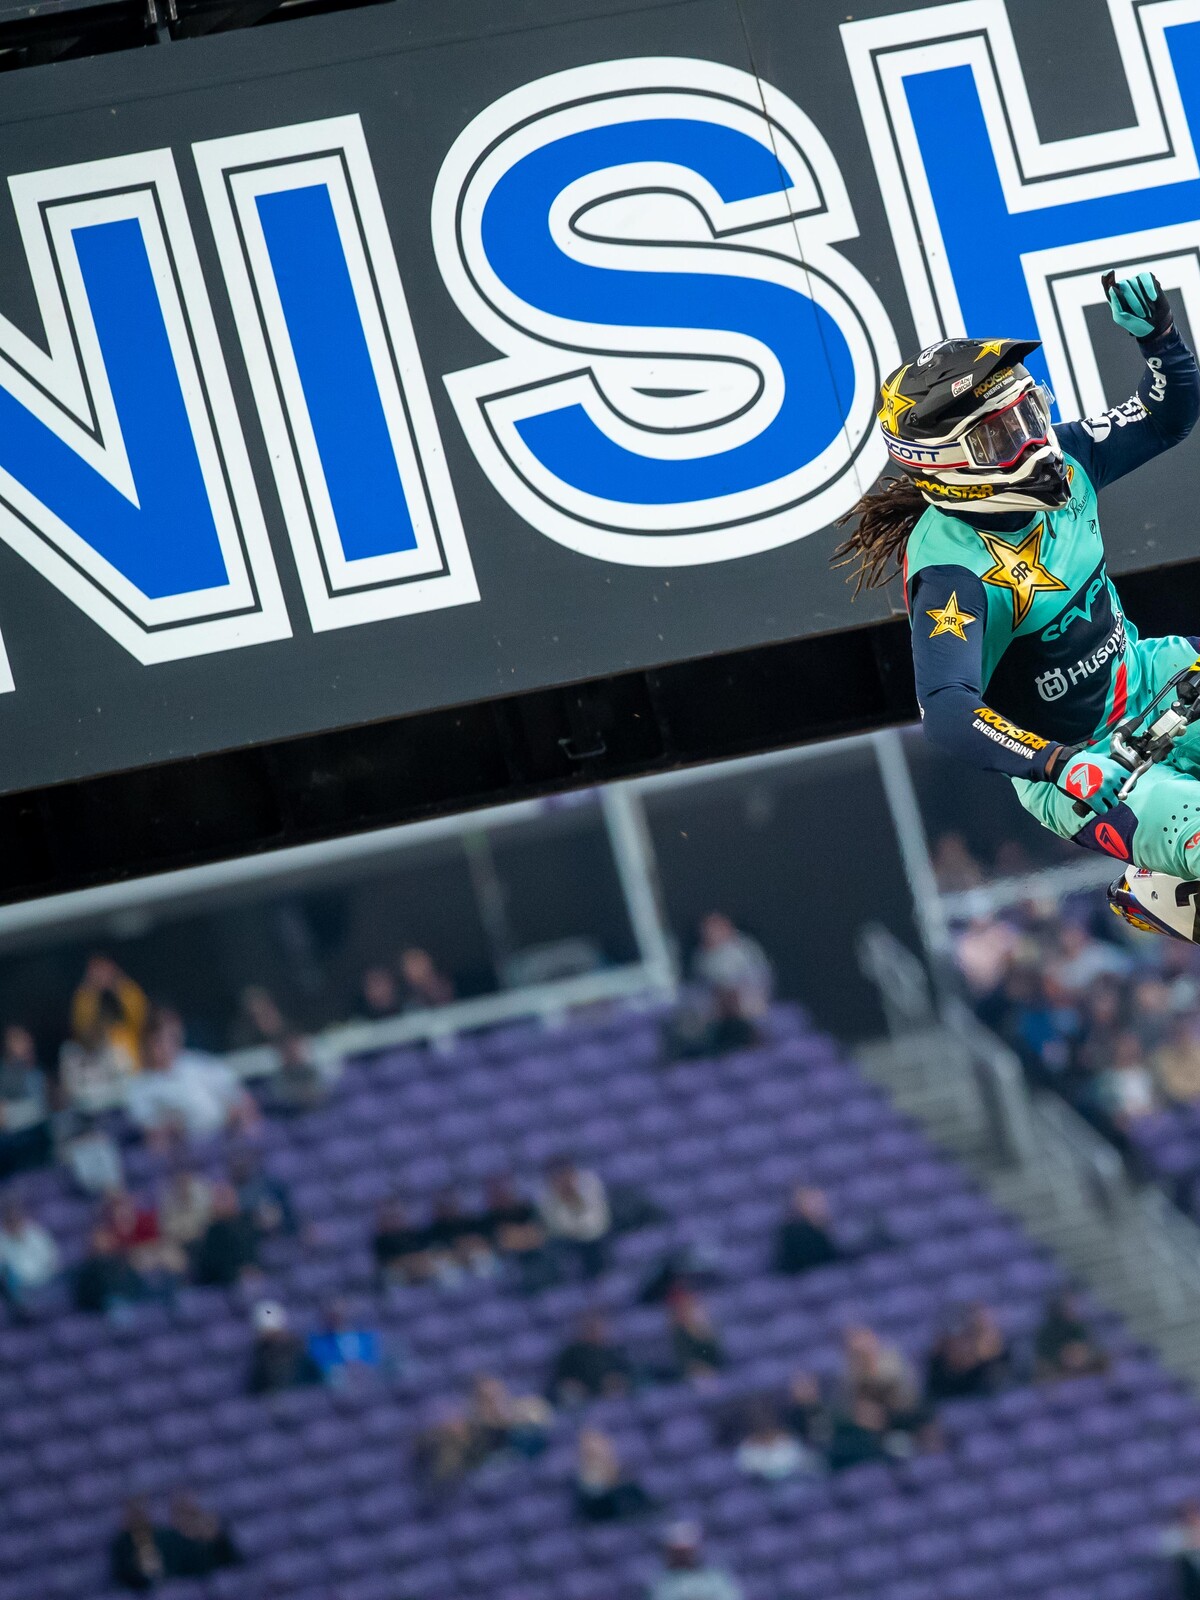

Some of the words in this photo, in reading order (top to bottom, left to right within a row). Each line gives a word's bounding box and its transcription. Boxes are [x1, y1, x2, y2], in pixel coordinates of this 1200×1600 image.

[972, 367, 1015, 399] ROCKSTAR
[914, 478, 995, 499] ROCKSTAR
[971, 718, 1007, 744] ENERGY
[1004, 738, 1036, 760] DRINK
[973, 707, 1050, 749] ROCKSTAR
